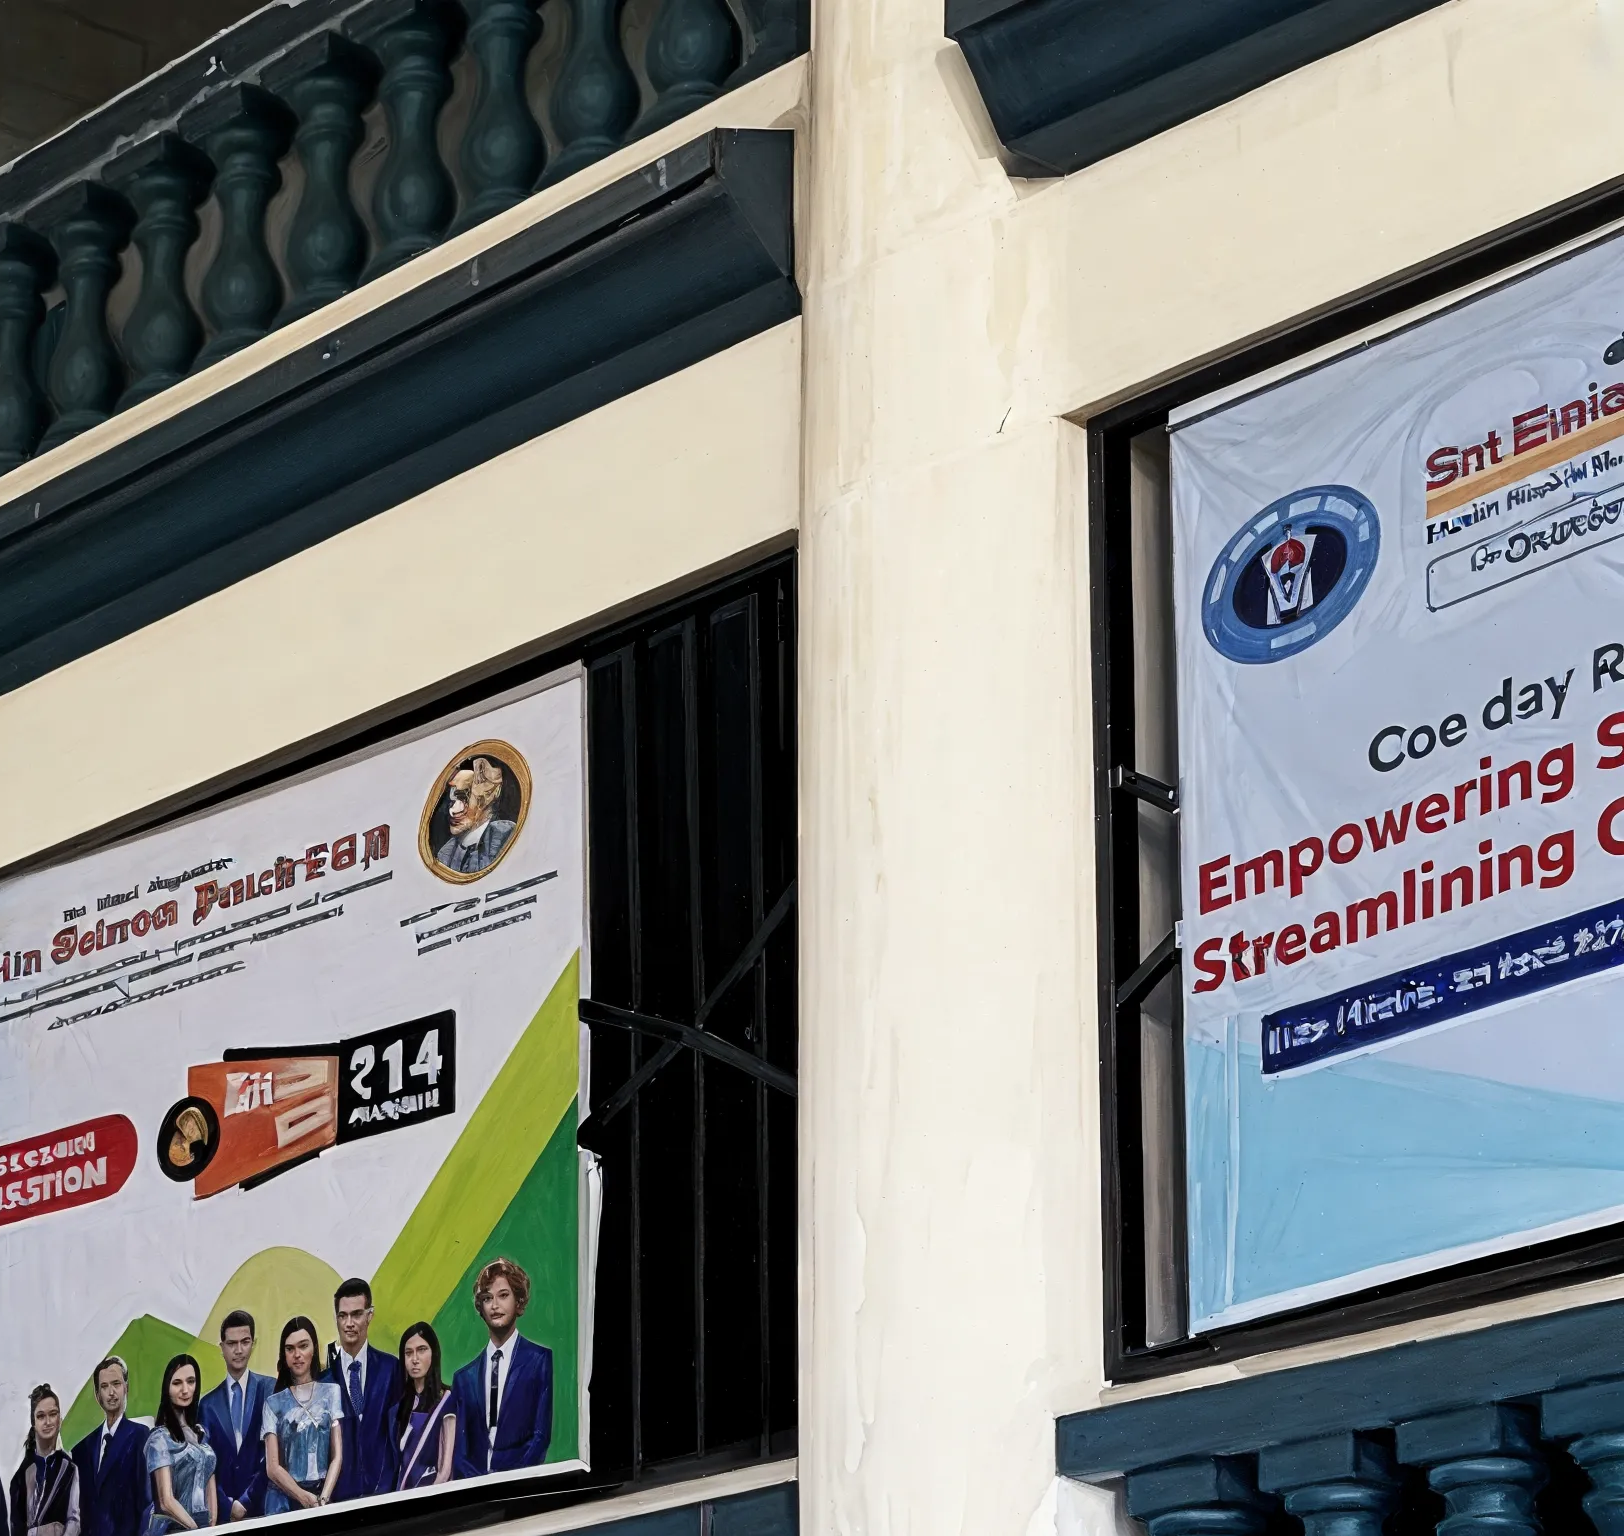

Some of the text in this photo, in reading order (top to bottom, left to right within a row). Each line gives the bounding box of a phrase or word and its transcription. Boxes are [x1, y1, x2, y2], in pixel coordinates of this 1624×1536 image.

[1367, 642, 1624, 773] Coe day R
[1191, 827, 1575, 994] Streamlining
[1198, 741, 1575, 916] Empowering
